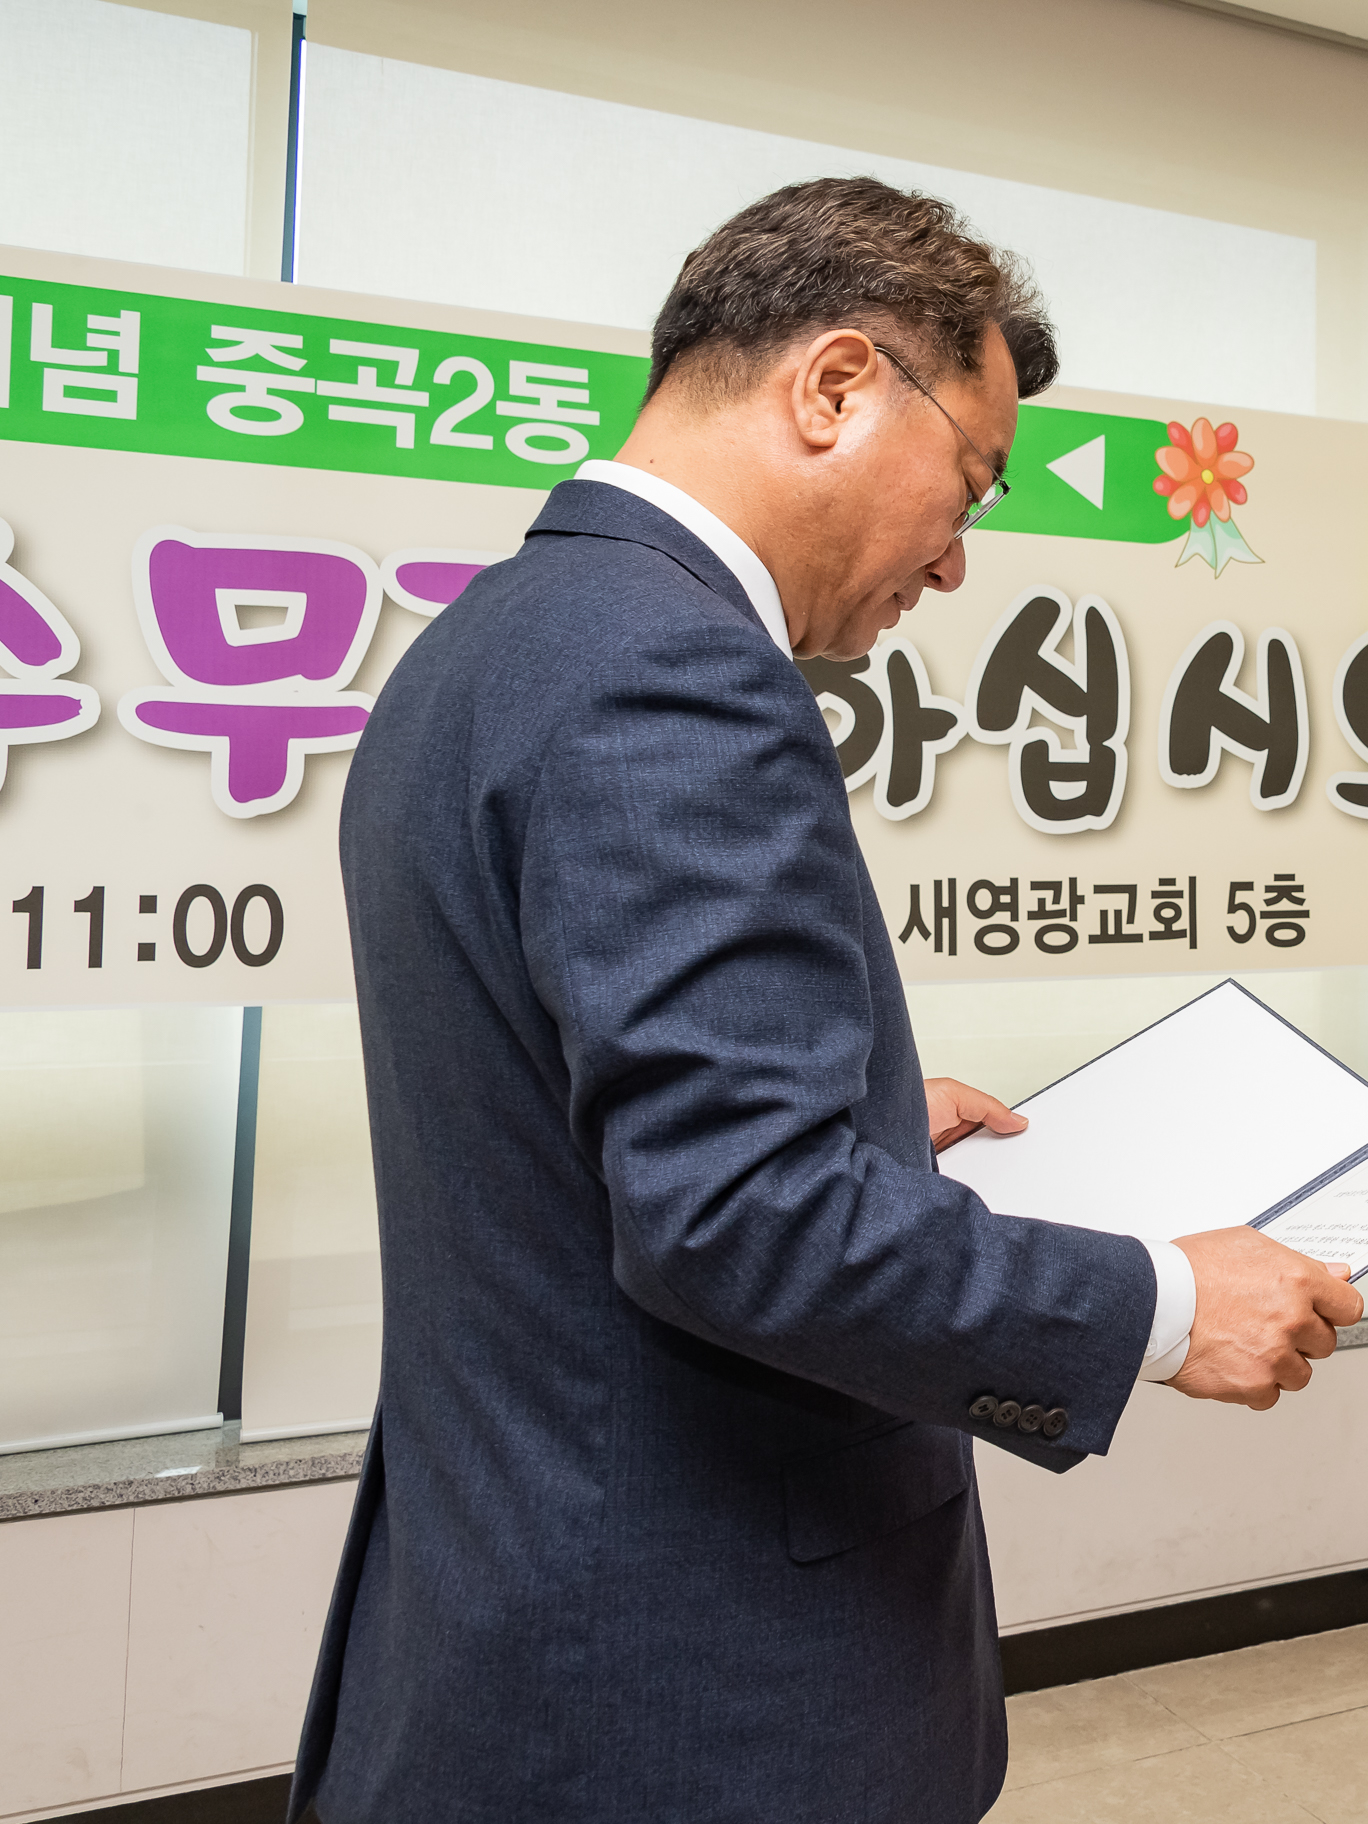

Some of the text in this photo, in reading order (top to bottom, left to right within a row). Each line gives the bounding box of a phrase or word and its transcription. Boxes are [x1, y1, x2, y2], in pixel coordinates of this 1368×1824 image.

[0, 294, 601, 465] 념 중곡2동
[12, 884, 285, 969] 11:00
[898, 873, 1311, 956] 새영광교회 5층
